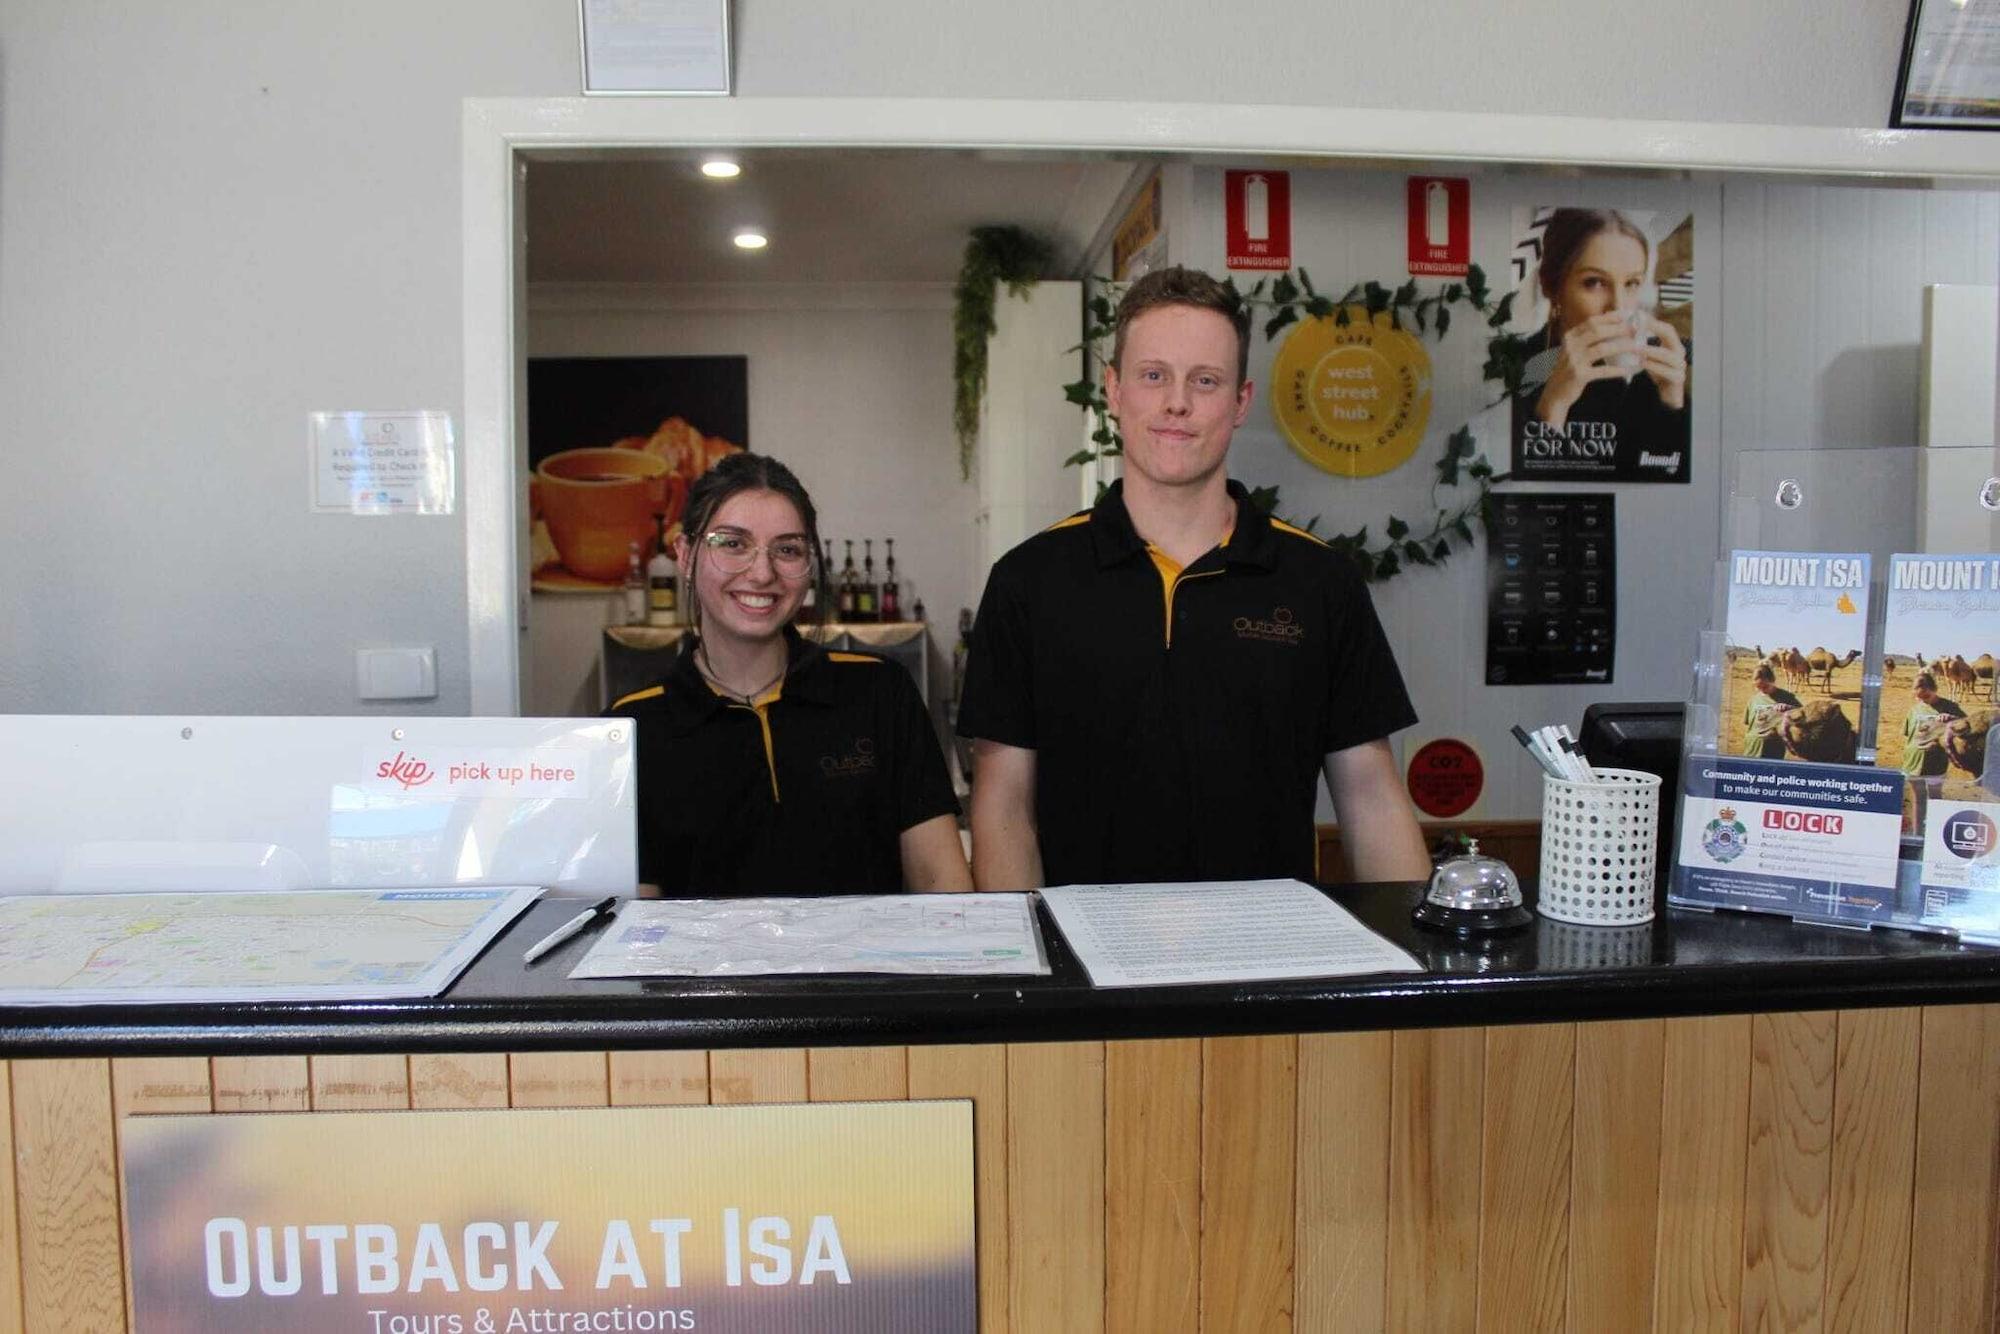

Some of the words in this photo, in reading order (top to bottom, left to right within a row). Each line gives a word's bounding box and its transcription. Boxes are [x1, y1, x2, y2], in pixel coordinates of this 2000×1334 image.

[1248, 243, 1268, 254] FIRE
[1428, 248, 1449, 259] FIRE
[1228, 256, 1290, 268] EXTINGUISHER
[1408, 261, 1467, 273] EXTINGUISHER
[1328, 365, 1374, 380] west
[1322, 385, 1380, 400] street
[1309, 424, 1361, 453] COFFEE
[1524, 420, 1617, 440] CRAFTED
[1523, 439, 1564, 457] FOR
[1568, 439, 1618, 458] NOW
[1734, 556, 1819, 588] MOUNT
[1823, 558, 1863, 589] ISA
[1894, 560, 1984, 592] MOUNT
[1990, 562, 2000, 591] I
[377, 751, 434, 791] skip
[450, 762, 490, 784] pick
[498, 767, 523, 785] up
[530, 762, 575, 781] here
[1702, 768, 1755, 784] Community
[1757, 773, 1776, 784] and
[1776, 774, 1806, 787] police
[1807, 777, 1847, 792] working
[1849, 781, 1893, 793] together
[1723, 783, 1733, 793] to
[1734, 784, 1760, 796] make
[1762, 788, 1778, 797] our
[1780, 788, 1841, 803] communities
[1844, 793, 1868, 805] safe.
[1766, 810, 1842, 834] LOCK
[594, 1218, 692, 1290] AT
[367, 1309, 462, 1334] Tours
[472, 1307, 496, 1334] &
[504, 1302, 696, 1334] Attractions
